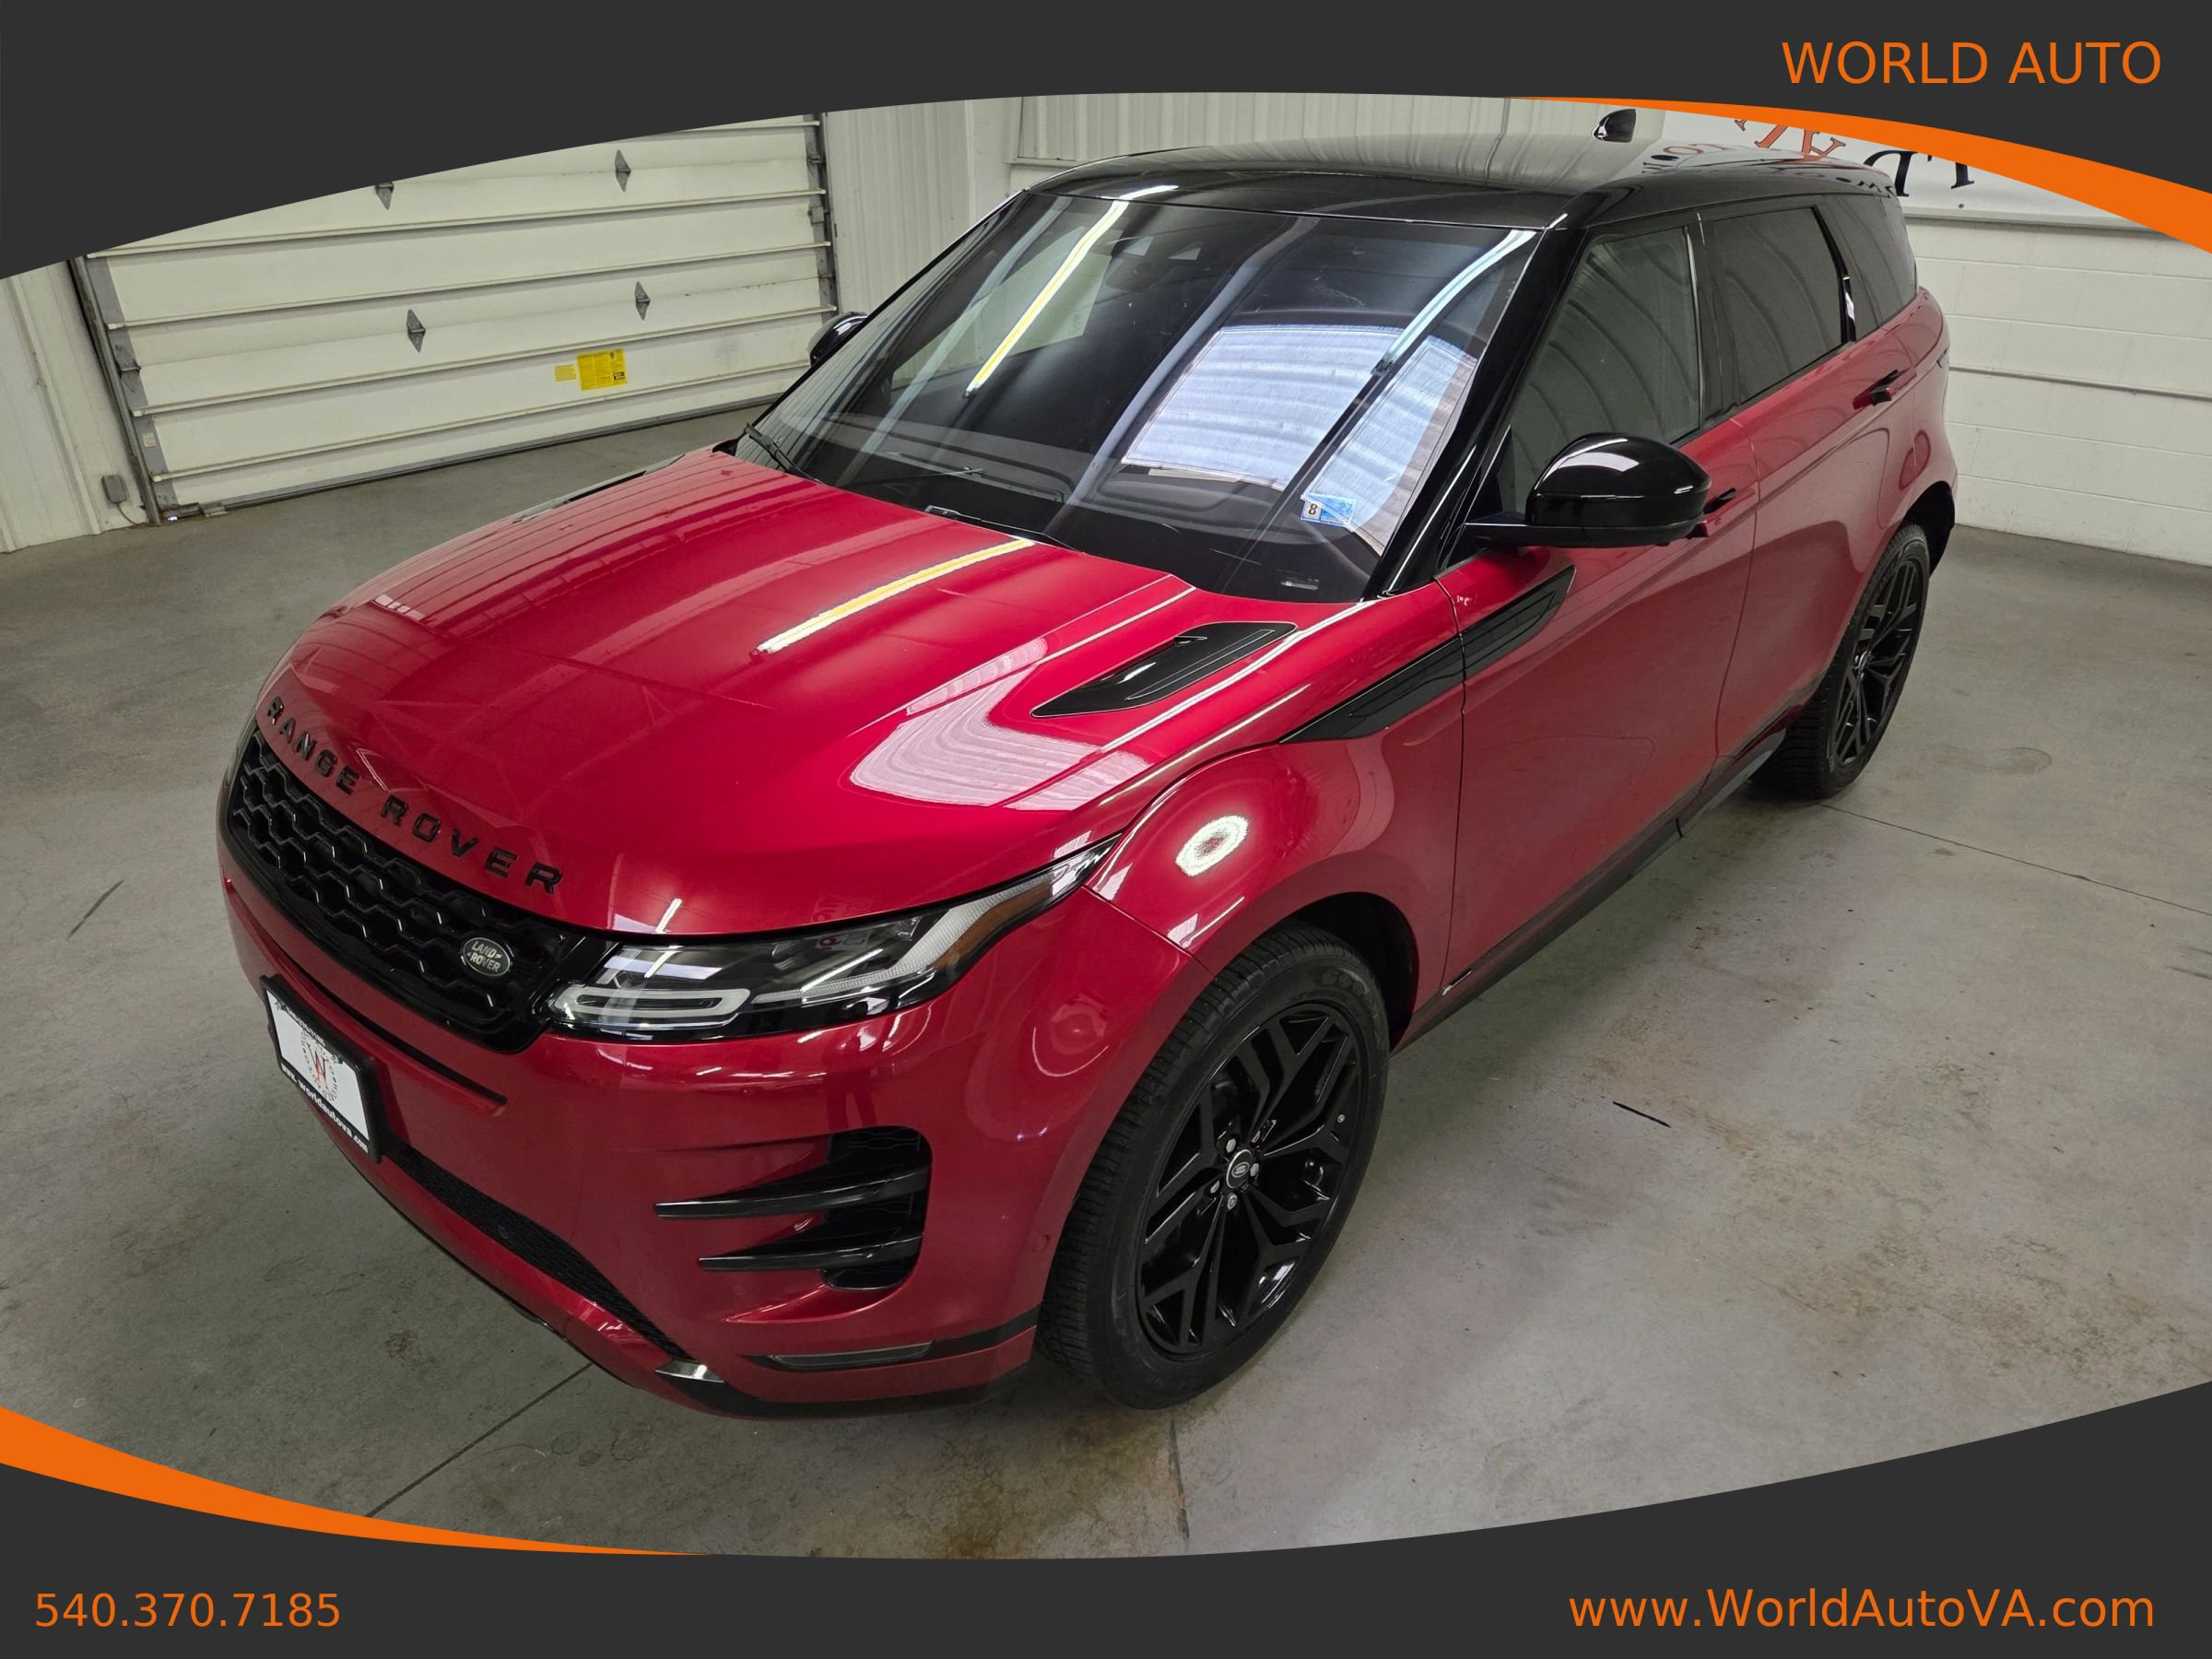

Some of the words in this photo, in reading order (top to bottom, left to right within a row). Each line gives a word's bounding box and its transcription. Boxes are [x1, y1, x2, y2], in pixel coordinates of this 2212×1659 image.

[1308, 502, 1318, 515] 8
[266, 696, 359, 795] RANGE
[381, 794, 564, 895] ROVER
[471, 940, 498, 959] LAND
[470, 951, 501, 972] ROVER
